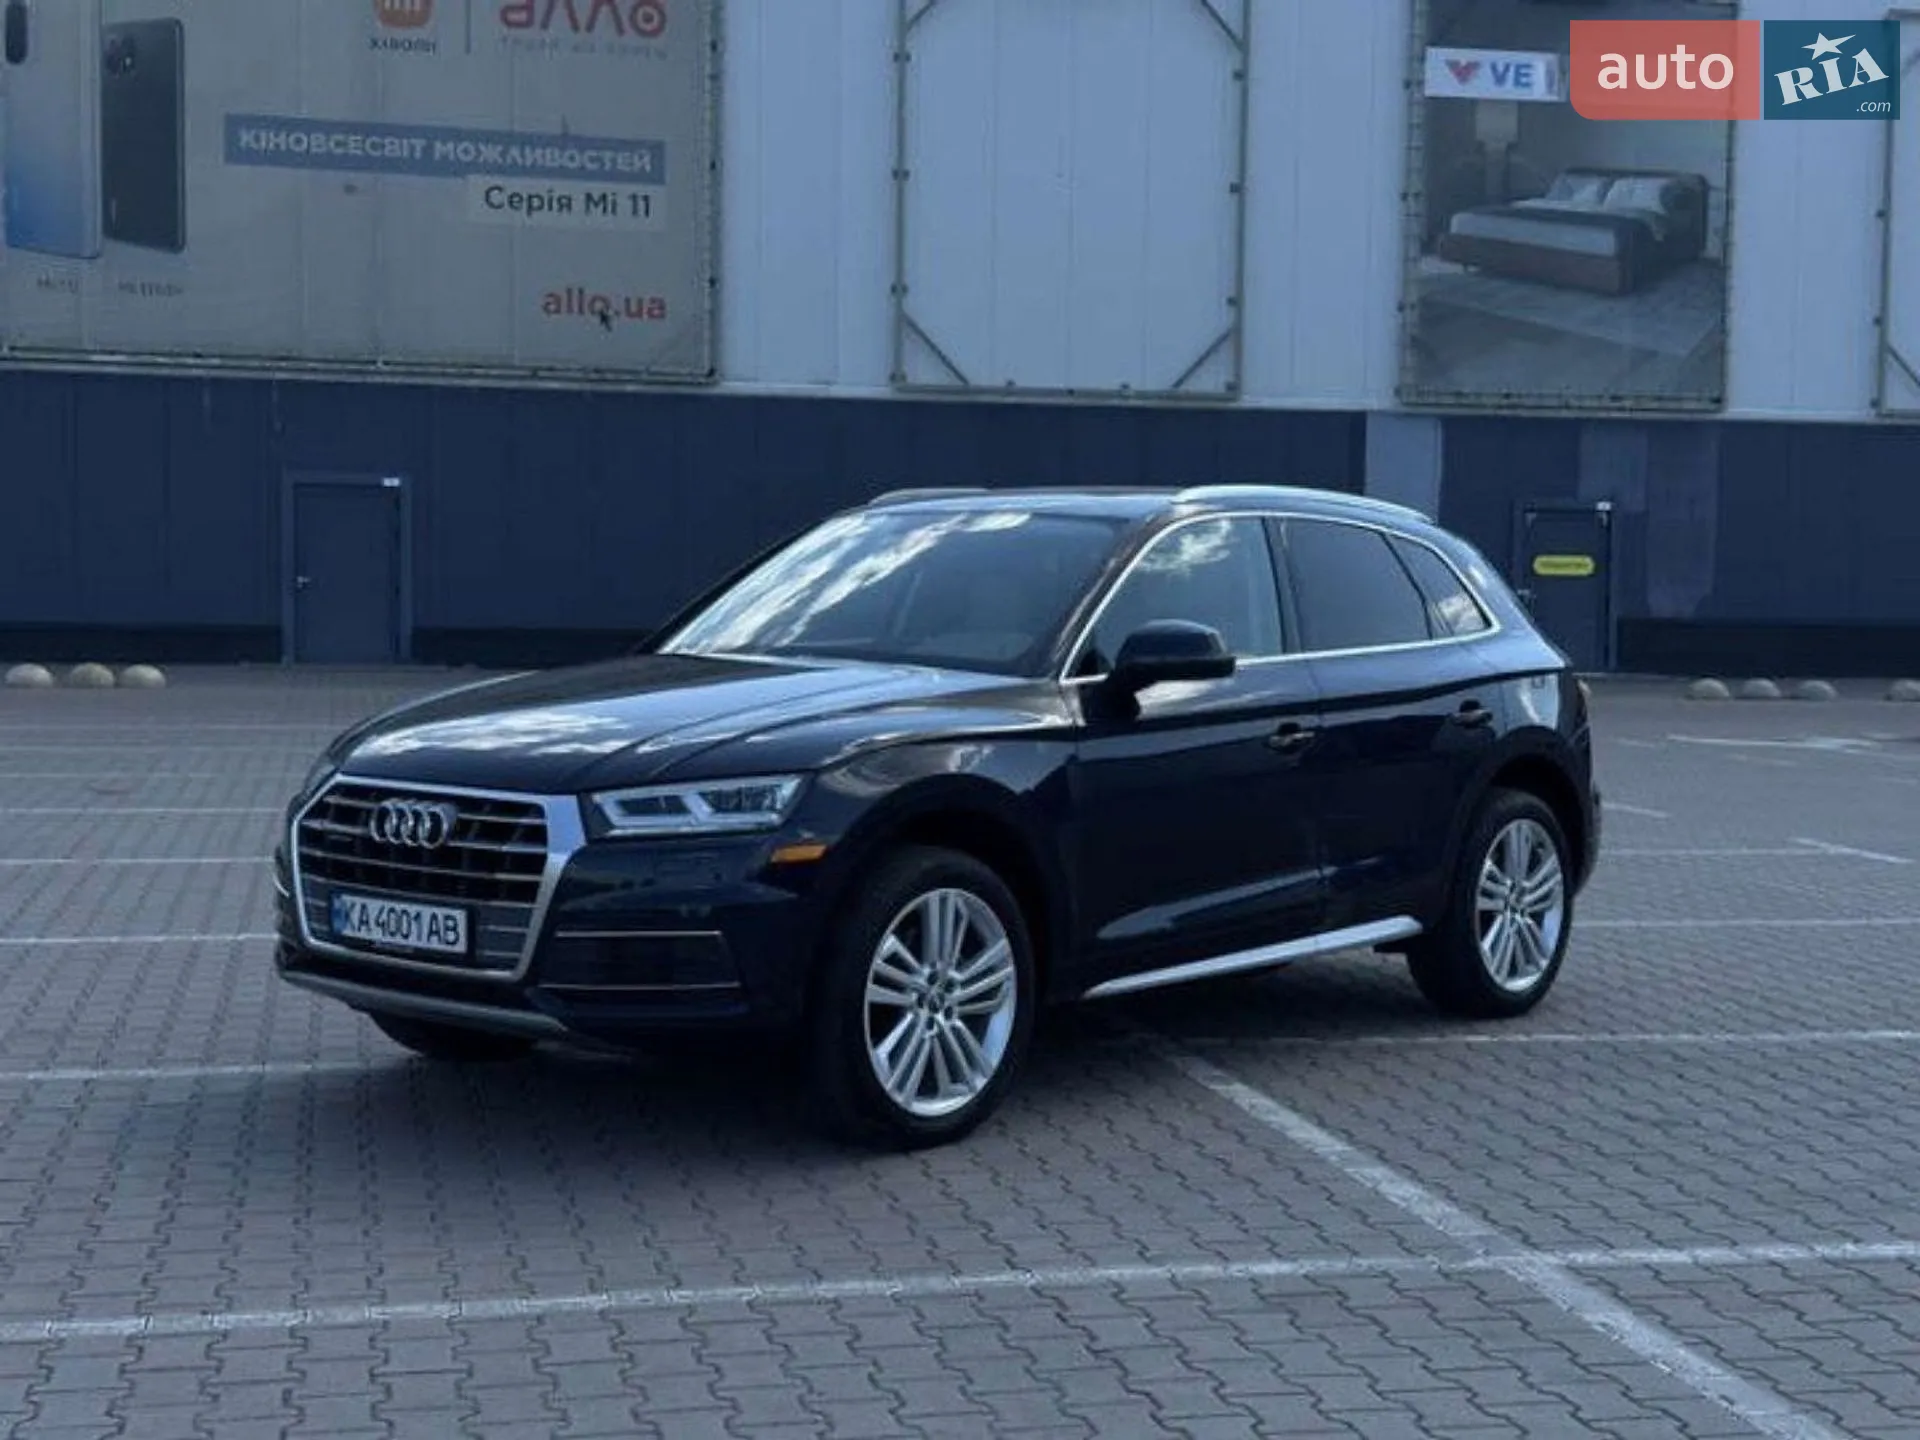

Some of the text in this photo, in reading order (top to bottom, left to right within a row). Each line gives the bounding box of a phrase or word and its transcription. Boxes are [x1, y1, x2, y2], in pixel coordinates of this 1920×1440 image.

[239, 128, 652, 173] КІНОВСЕСВІТ МОЖЛИВОСТЕЙ
[484, 186, 651, 218] Серія Mi 11
[542, 287, 667, 319] allo.ua
